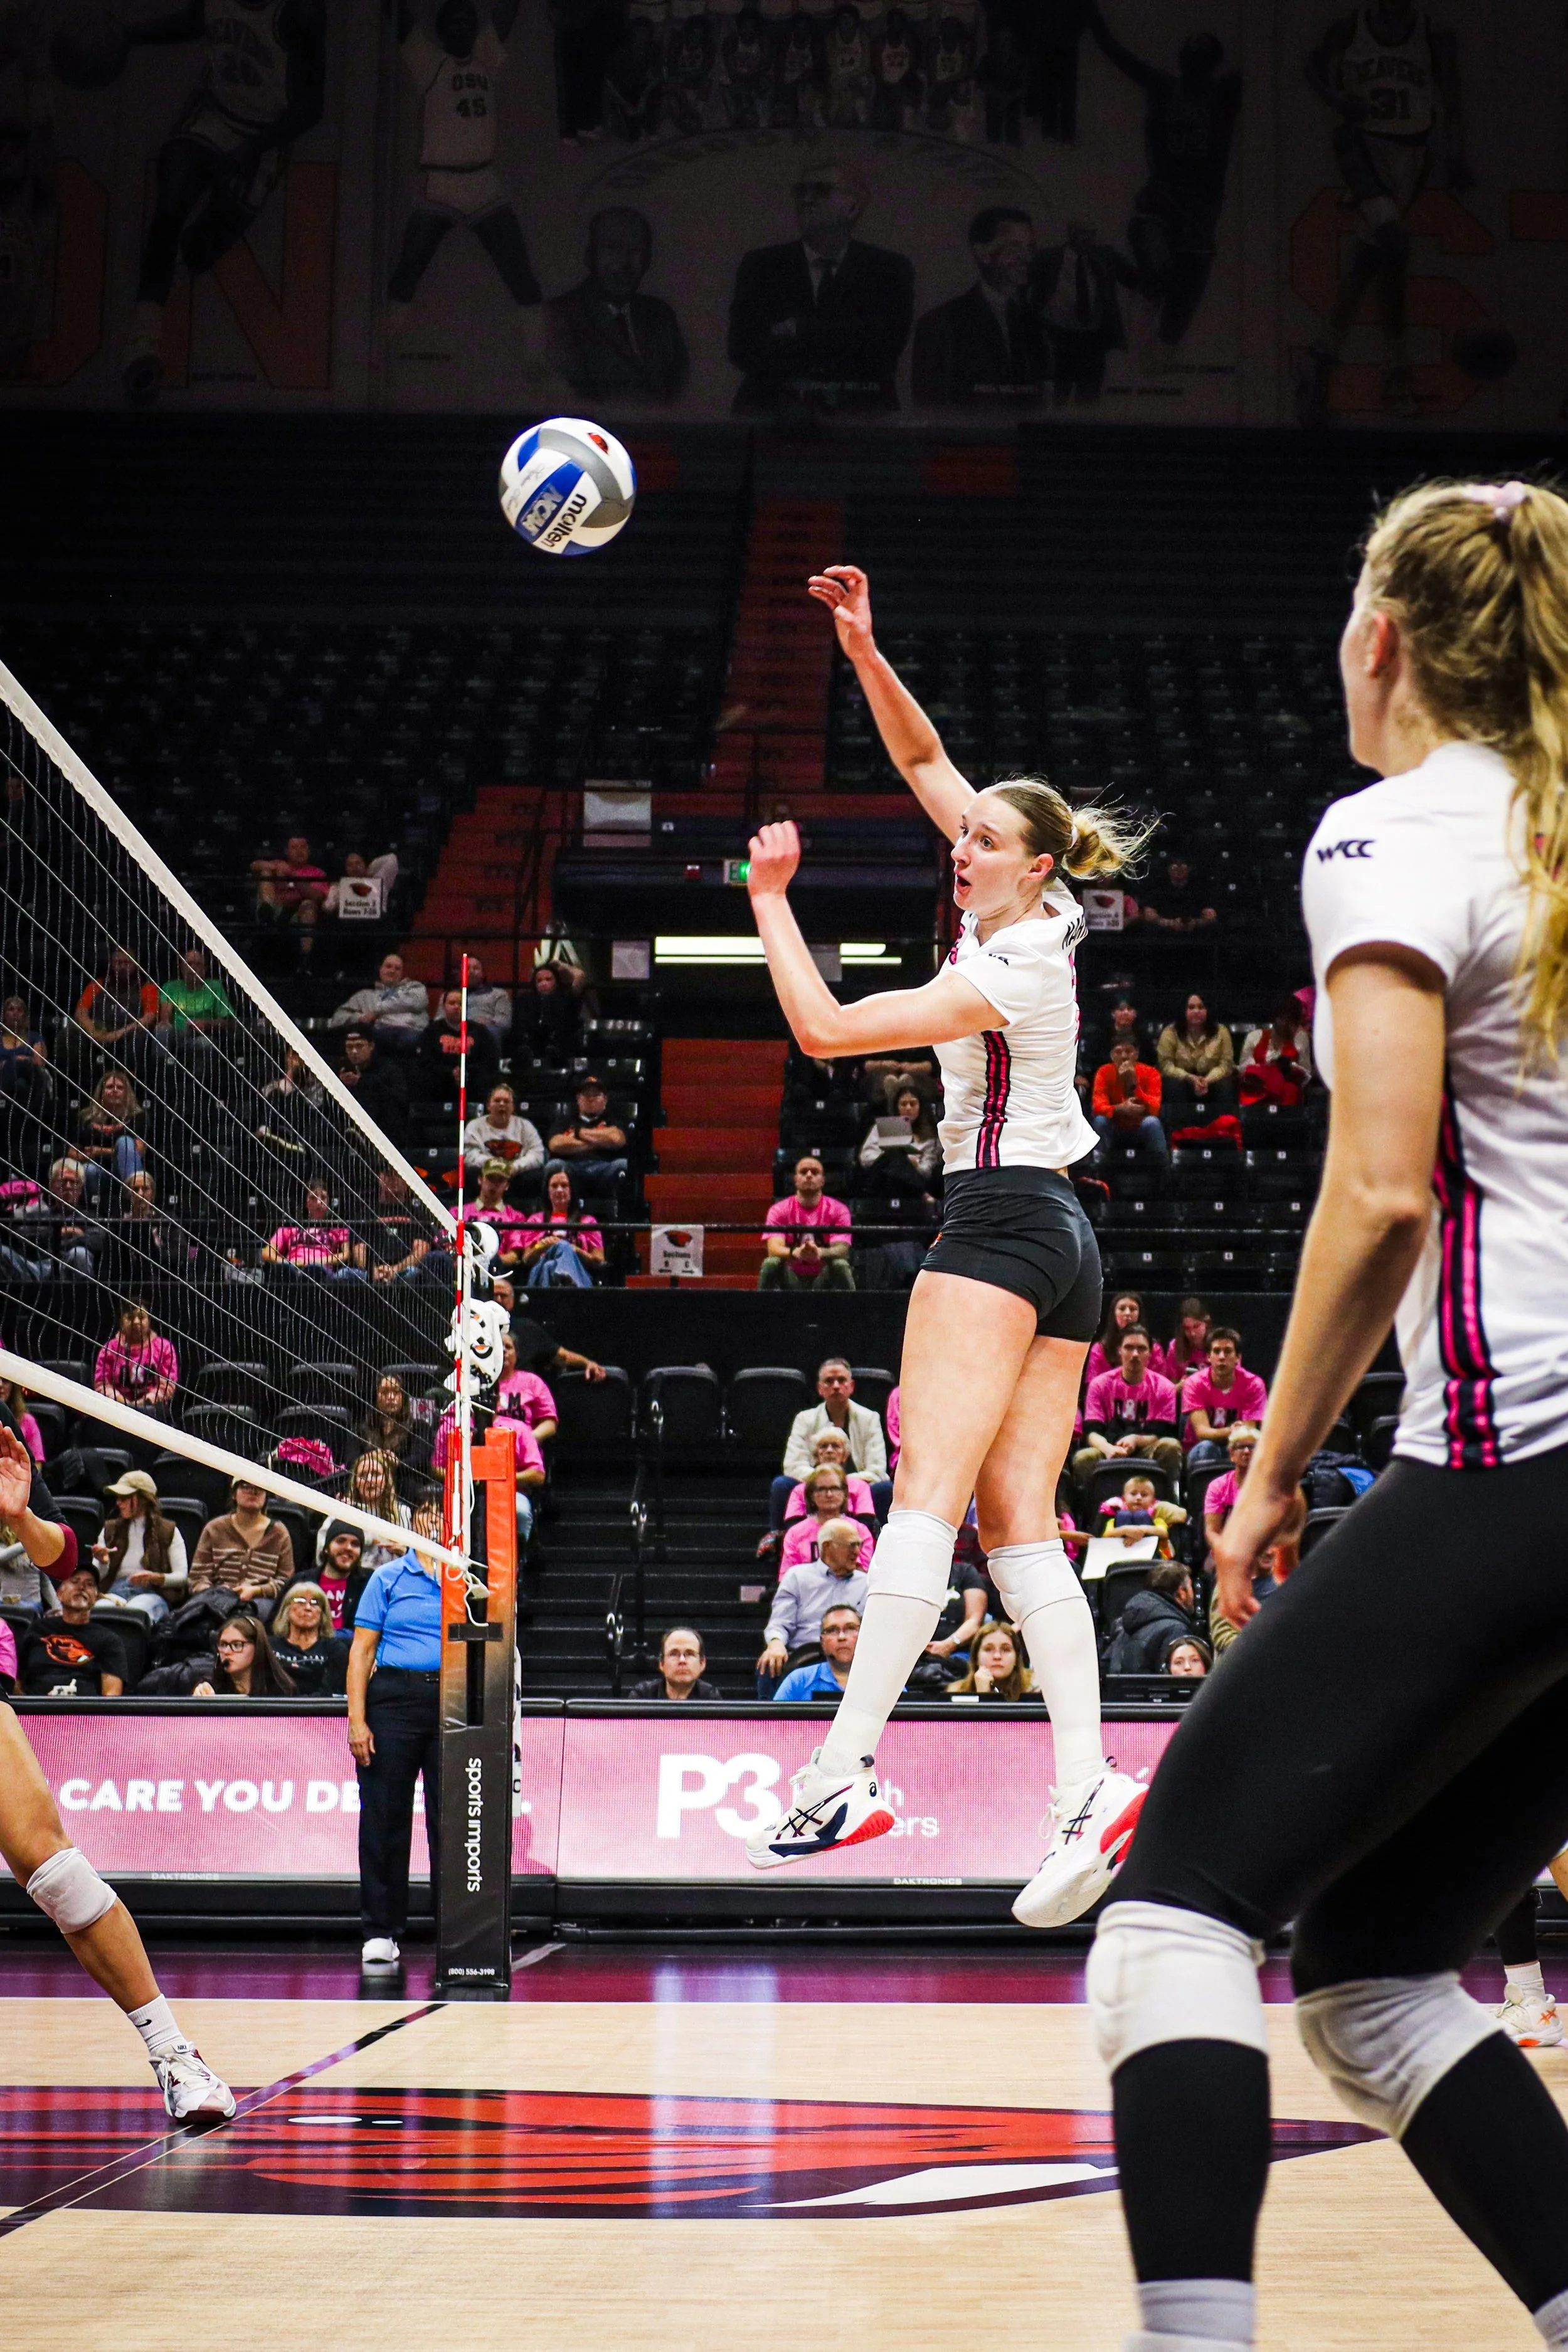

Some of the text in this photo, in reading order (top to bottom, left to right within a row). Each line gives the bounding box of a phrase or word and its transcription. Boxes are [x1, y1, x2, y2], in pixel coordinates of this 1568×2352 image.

[541, 494, 587, 547] molten
[1317, 839, 1375, 863] WCC
[59, 1777, 185, 1812] CARE
[194, 1779, 295, 1813] YOU
[656, 1752, 781, 1840] P3
[464, 1757, 484, 1892] sports imports
[151, 1872, 220, 1881] DAKTRONICS
[893, 1877, 962, 1885] DAKTRONICS
[448, 1968, 465, 1976] (800)
